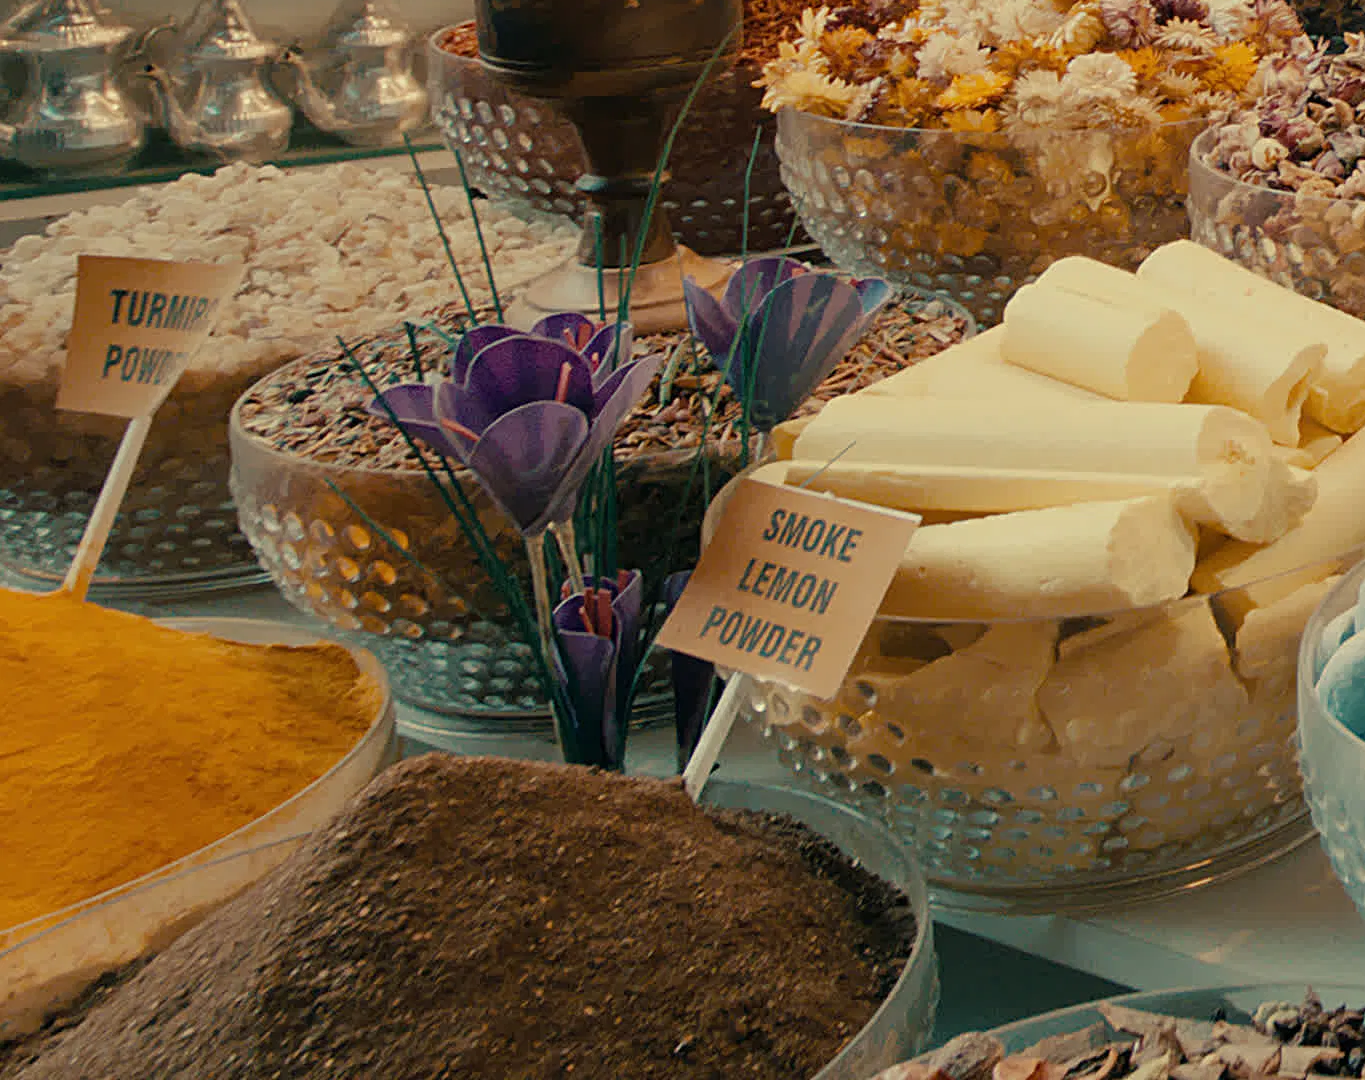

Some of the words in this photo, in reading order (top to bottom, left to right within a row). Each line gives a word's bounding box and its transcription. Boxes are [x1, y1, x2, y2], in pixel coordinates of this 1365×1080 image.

[762, 508, 863, 563] SMOKE
[736, 557, 839, 615] LEMON
[700, 605, 823, 672] POWDER
